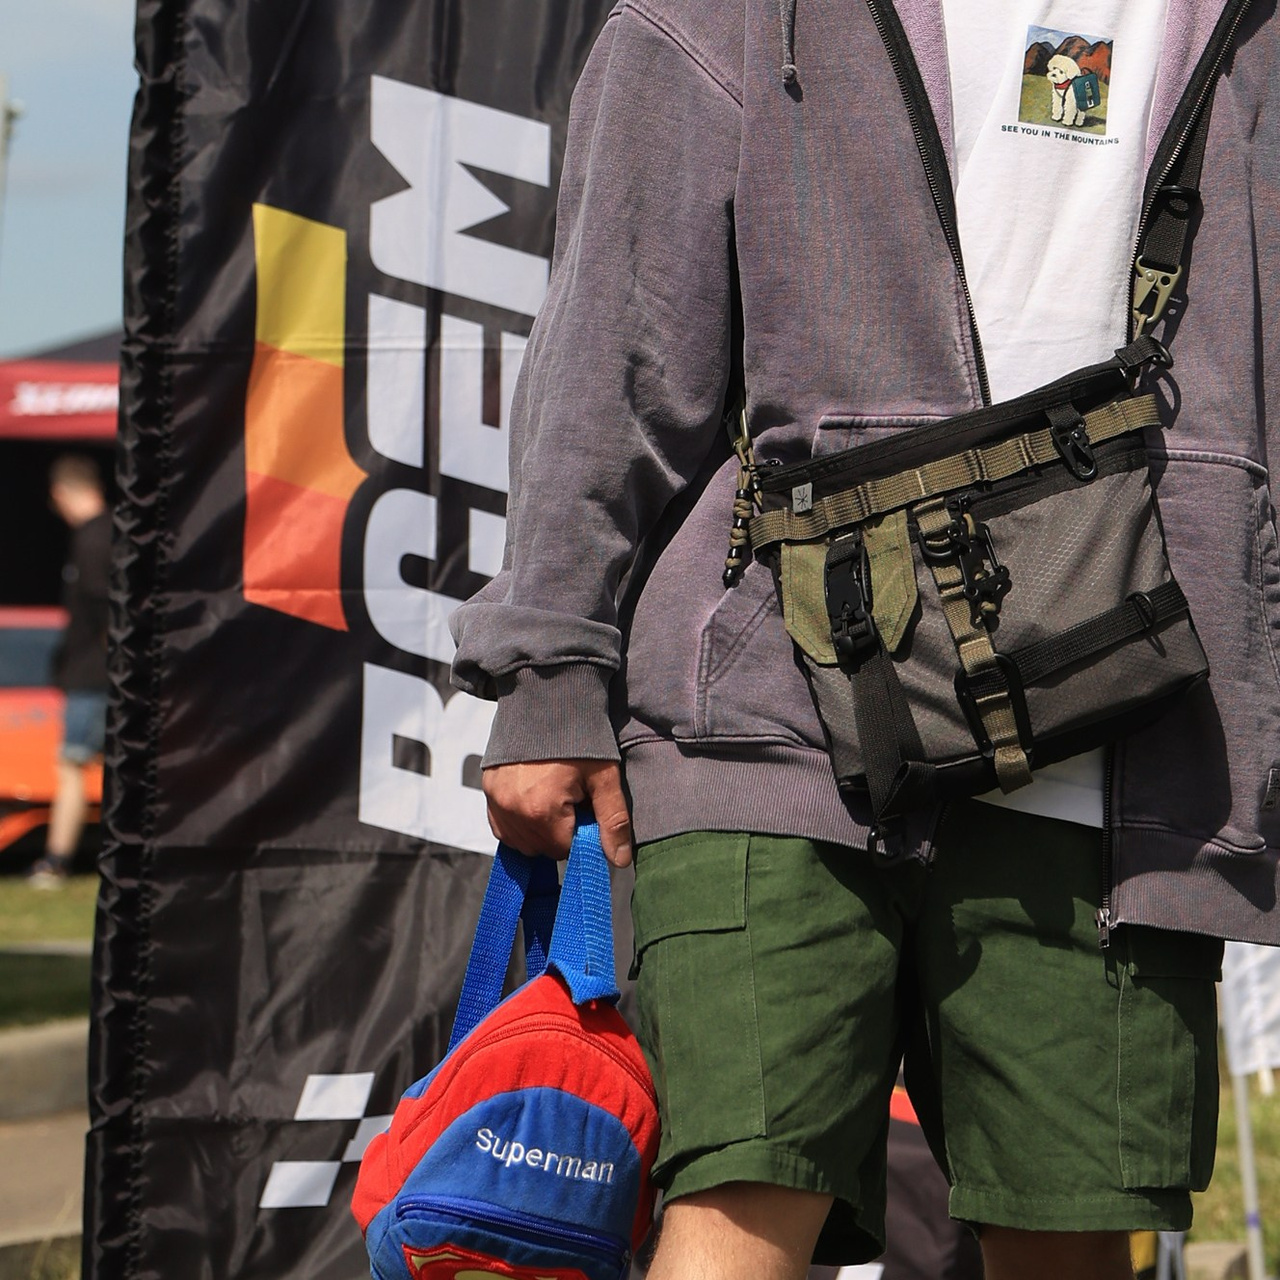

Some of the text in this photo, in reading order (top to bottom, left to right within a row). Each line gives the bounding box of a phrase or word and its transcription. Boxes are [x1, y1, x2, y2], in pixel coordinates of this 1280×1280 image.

[1001, 124, 1018, 133] SEE
[1021, 127, 1039, 136] YOU
[1054, 132, 1070, 140] THE
[1071, 135, 1120, 146] MOUNTAINS
[475, 1127, 616, 1184] Superman
